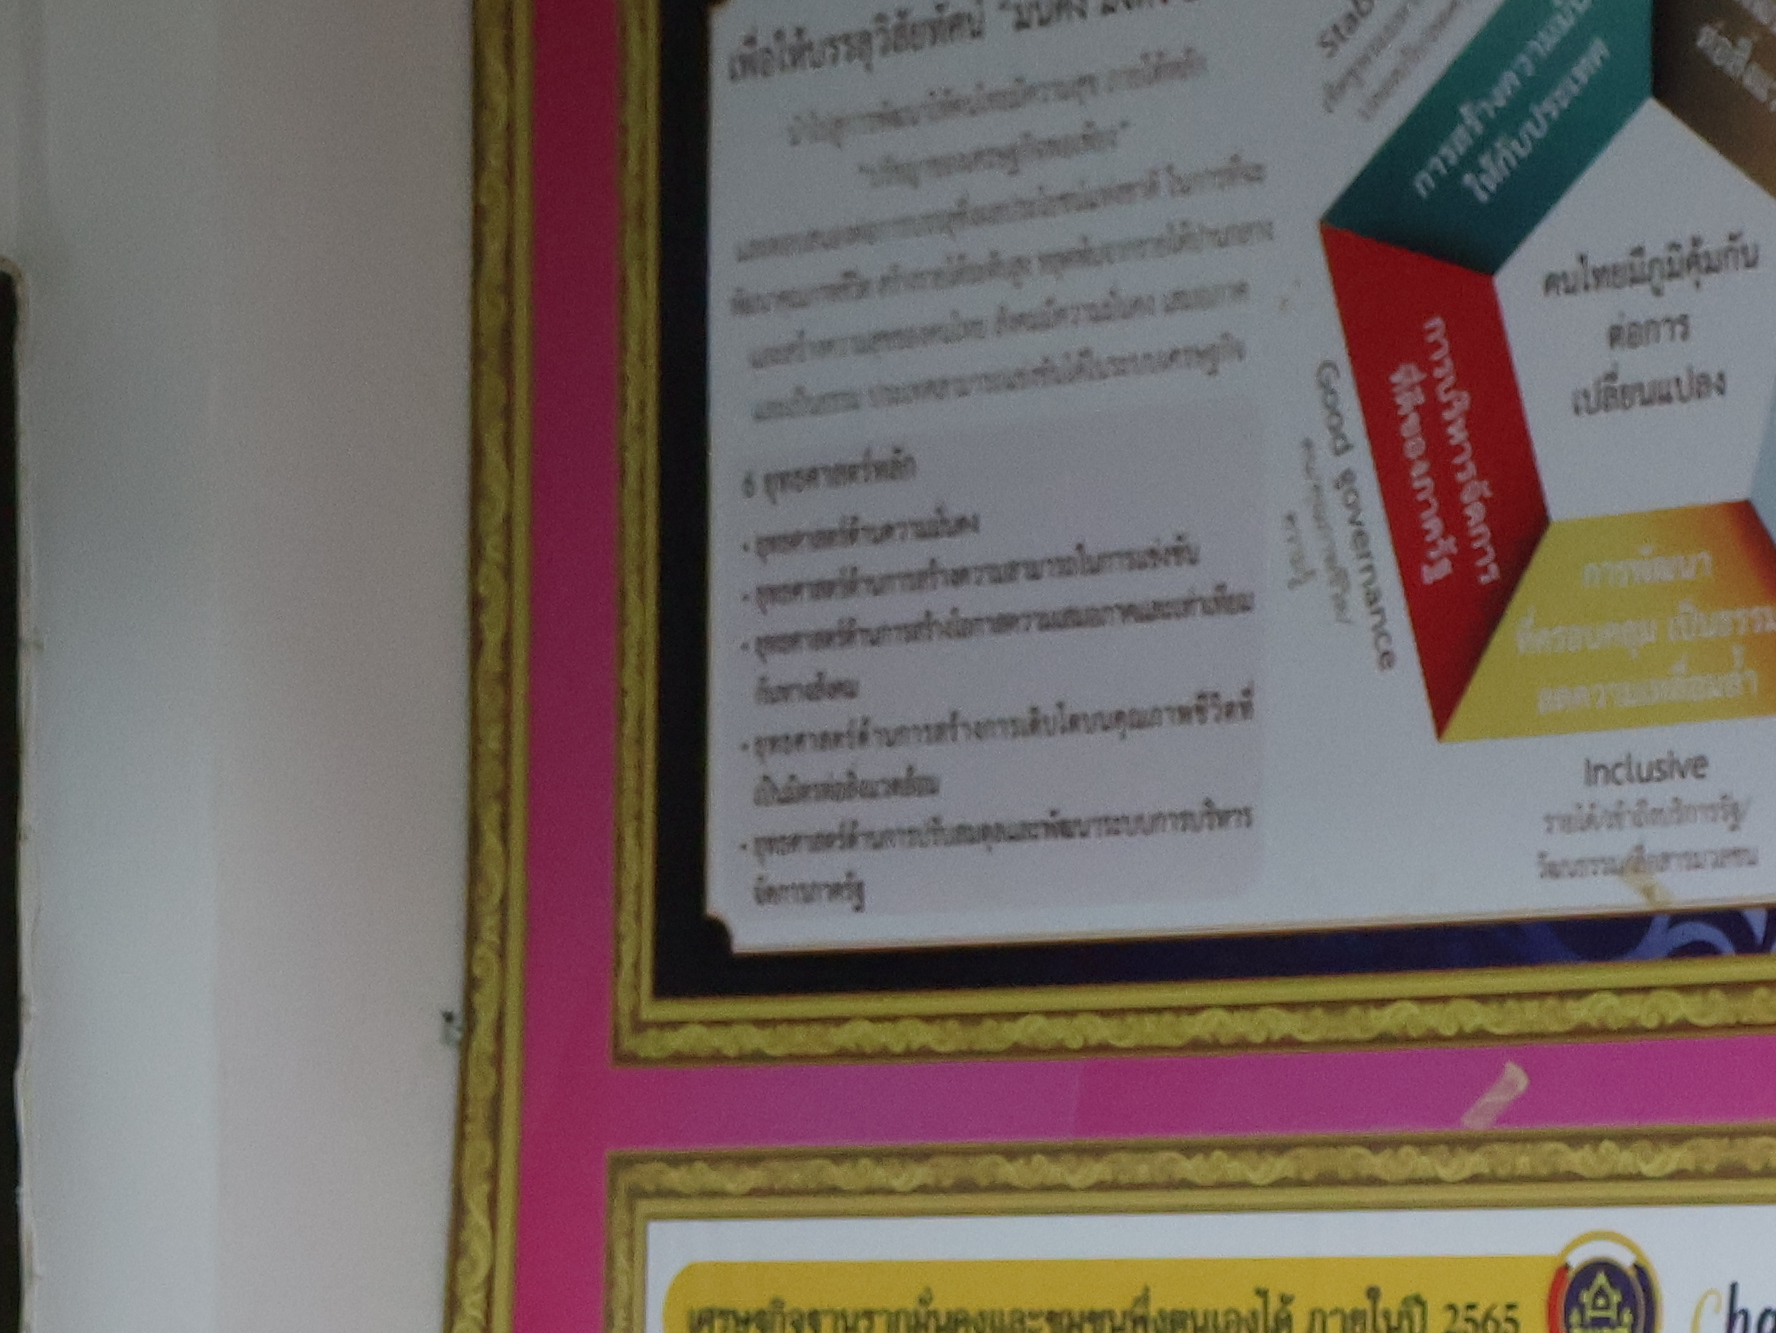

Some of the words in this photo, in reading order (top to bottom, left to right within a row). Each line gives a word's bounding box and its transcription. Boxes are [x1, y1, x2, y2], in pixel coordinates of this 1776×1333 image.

[1314, 359, 1351, 457] Good
[1337, 465, 1394, 672] governance
[1583, 749, 1710, 787] Inclusive
